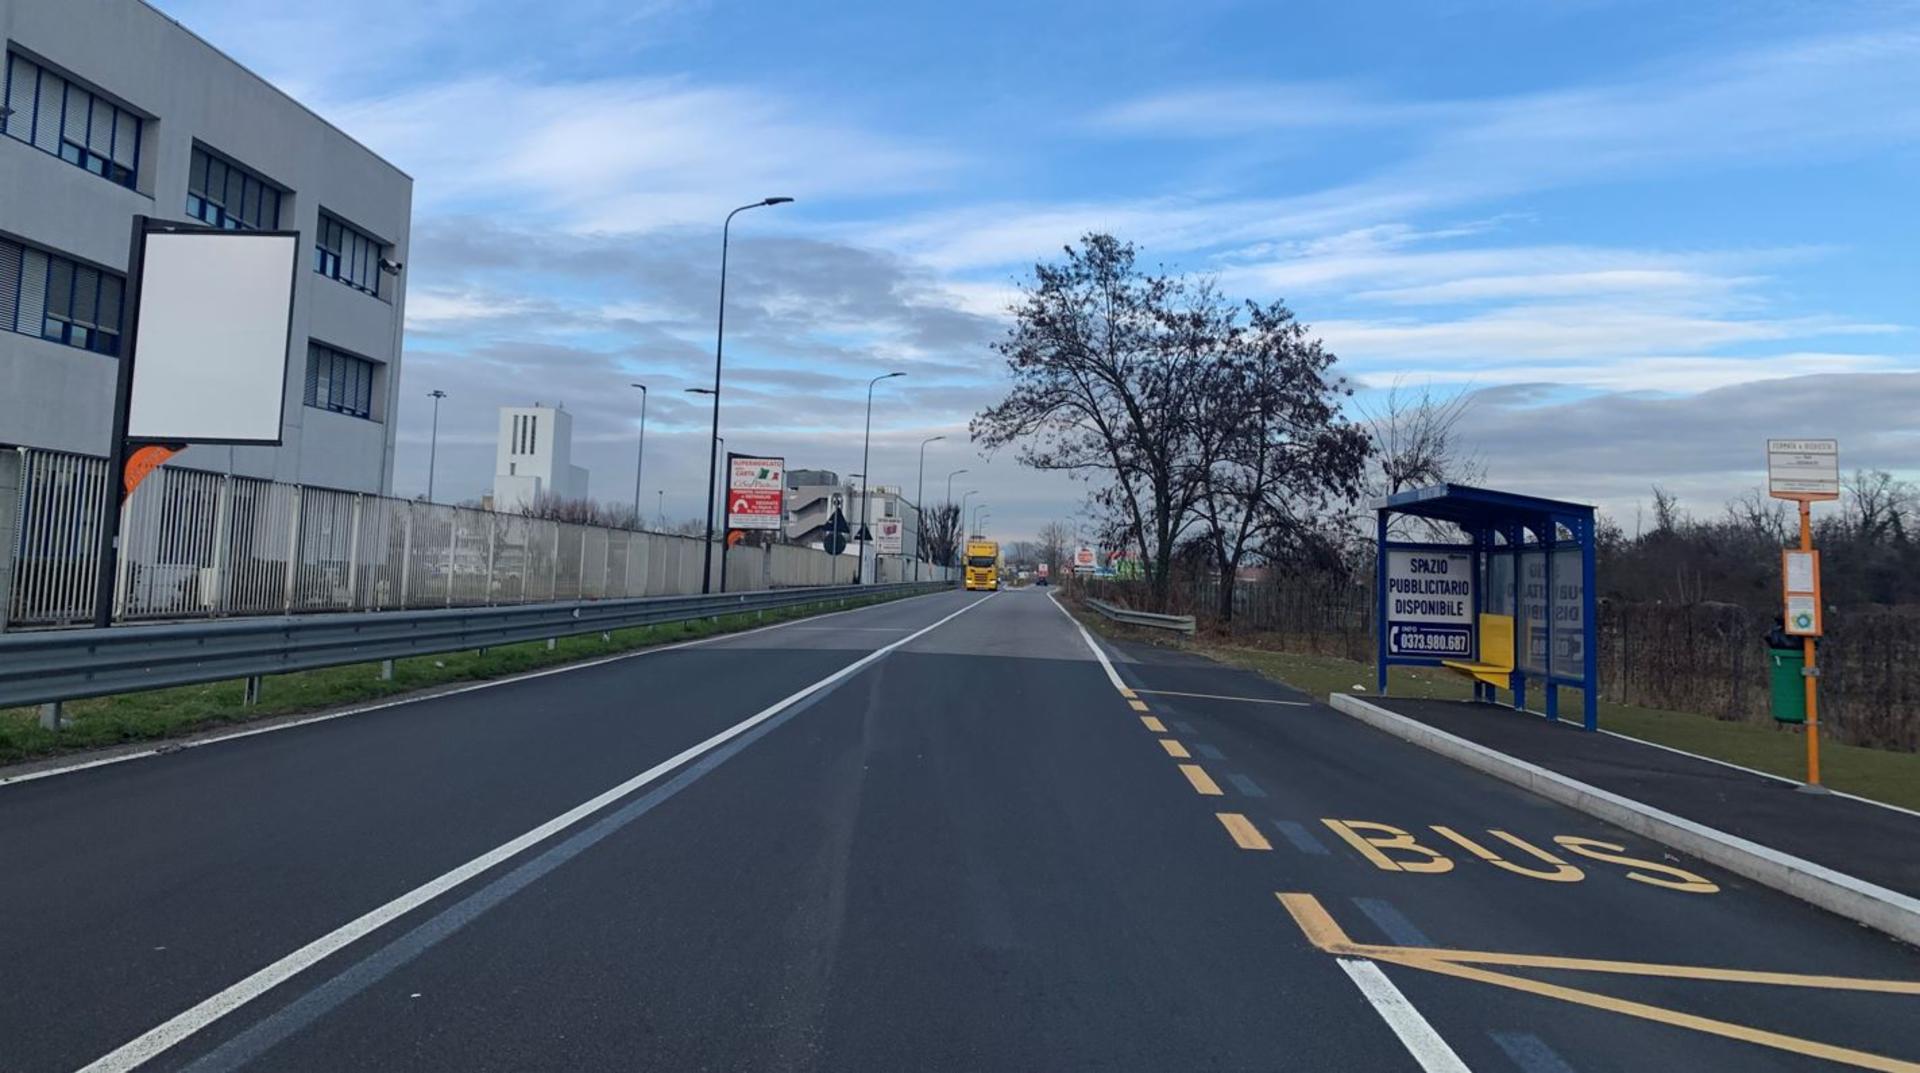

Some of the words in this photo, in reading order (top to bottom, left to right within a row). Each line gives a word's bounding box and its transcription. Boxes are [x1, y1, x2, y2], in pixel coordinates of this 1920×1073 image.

[1410, 558, 1448, 574] SPAZIO
[1389, 578, 1469, 596] PUBBLICITARIO
[1395, 599, 1464, 616] DISPONIBILE
[1401, 633, 1466, 650] 0373.980.687
[1320, 818, 1720, 893] BUS
